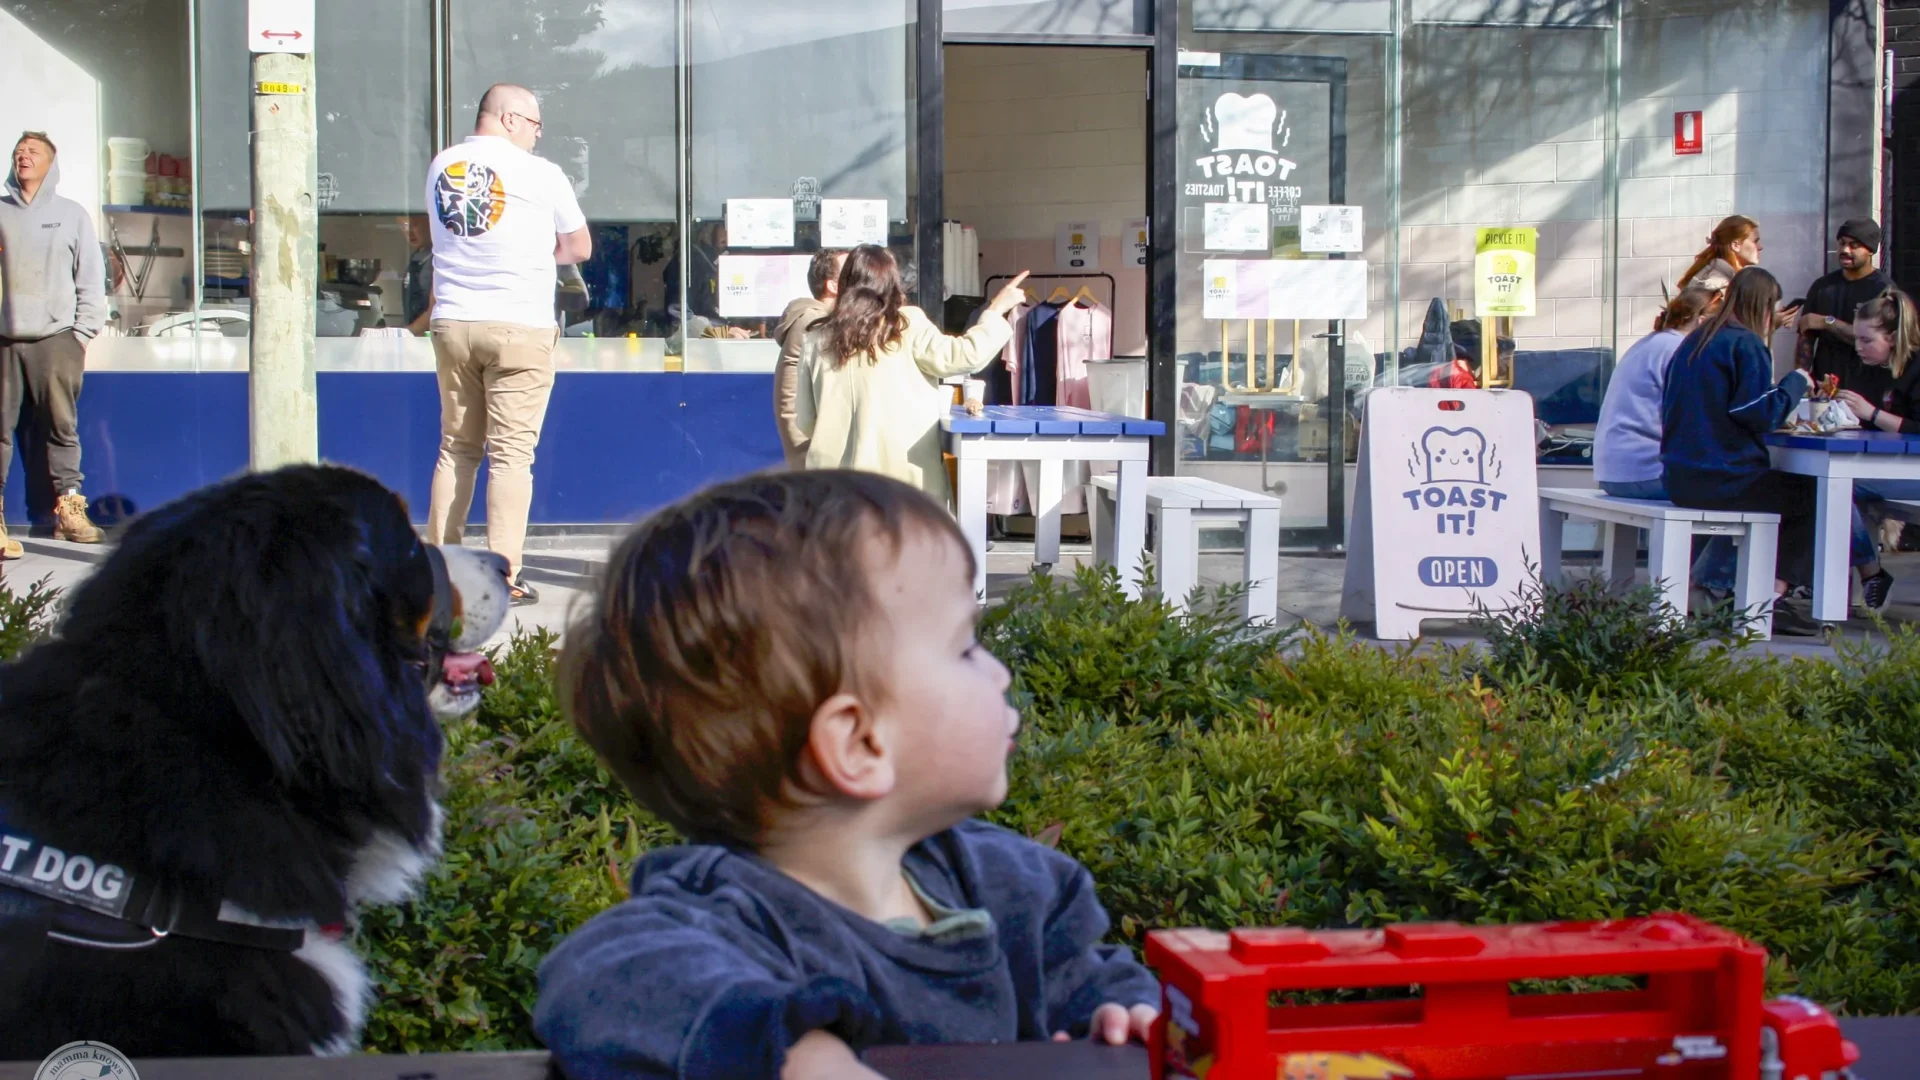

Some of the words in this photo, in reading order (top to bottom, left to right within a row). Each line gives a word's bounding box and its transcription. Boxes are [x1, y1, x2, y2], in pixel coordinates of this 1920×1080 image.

[1485, 233, 1512, 245] PICKLE
[1515, 233, 1526, 245] IT!
[1488, 275, 1522, 284] TOAST
[1498, 283, 1511, 292] IT!
[1402, 486, 1508, 512] TOAST
[1436, 509, 1476, 536] IT!
[1430, 559, 1485, 584] OPEN
[32, 845, 125, 899] DOG
